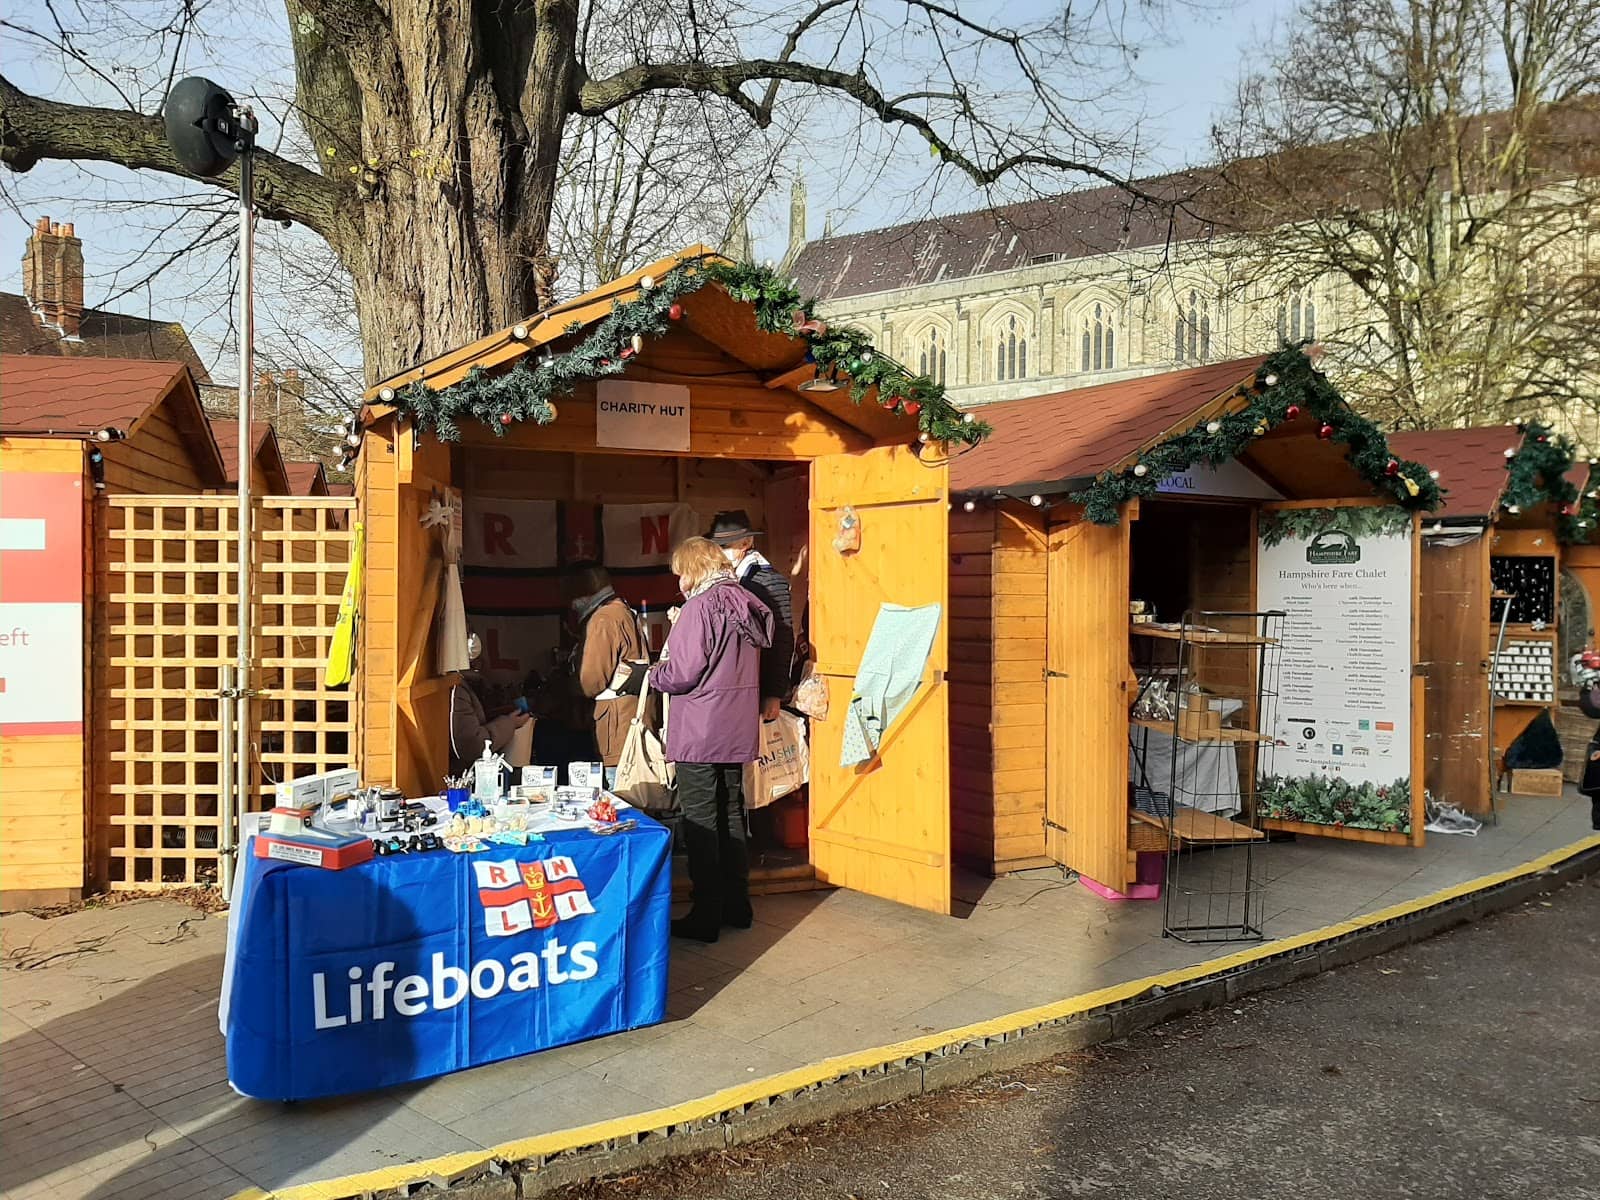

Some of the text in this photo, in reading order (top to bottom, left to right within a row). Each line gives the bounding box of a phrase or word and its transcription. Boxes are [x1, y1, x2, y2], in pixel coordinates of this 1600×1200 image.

[600, 401, 685, 416] CHARITY HUT
[1160, 476, 1195, 488] LOCAL
[484, 512, 671, 556] R N
[1279, 568, 1387, 580] Hampshire Fare Chalet
[489, 859, 568, 884] R N
[501, 910, 518, 931] L
[313, 937, 598, 1030] Lifeboats
